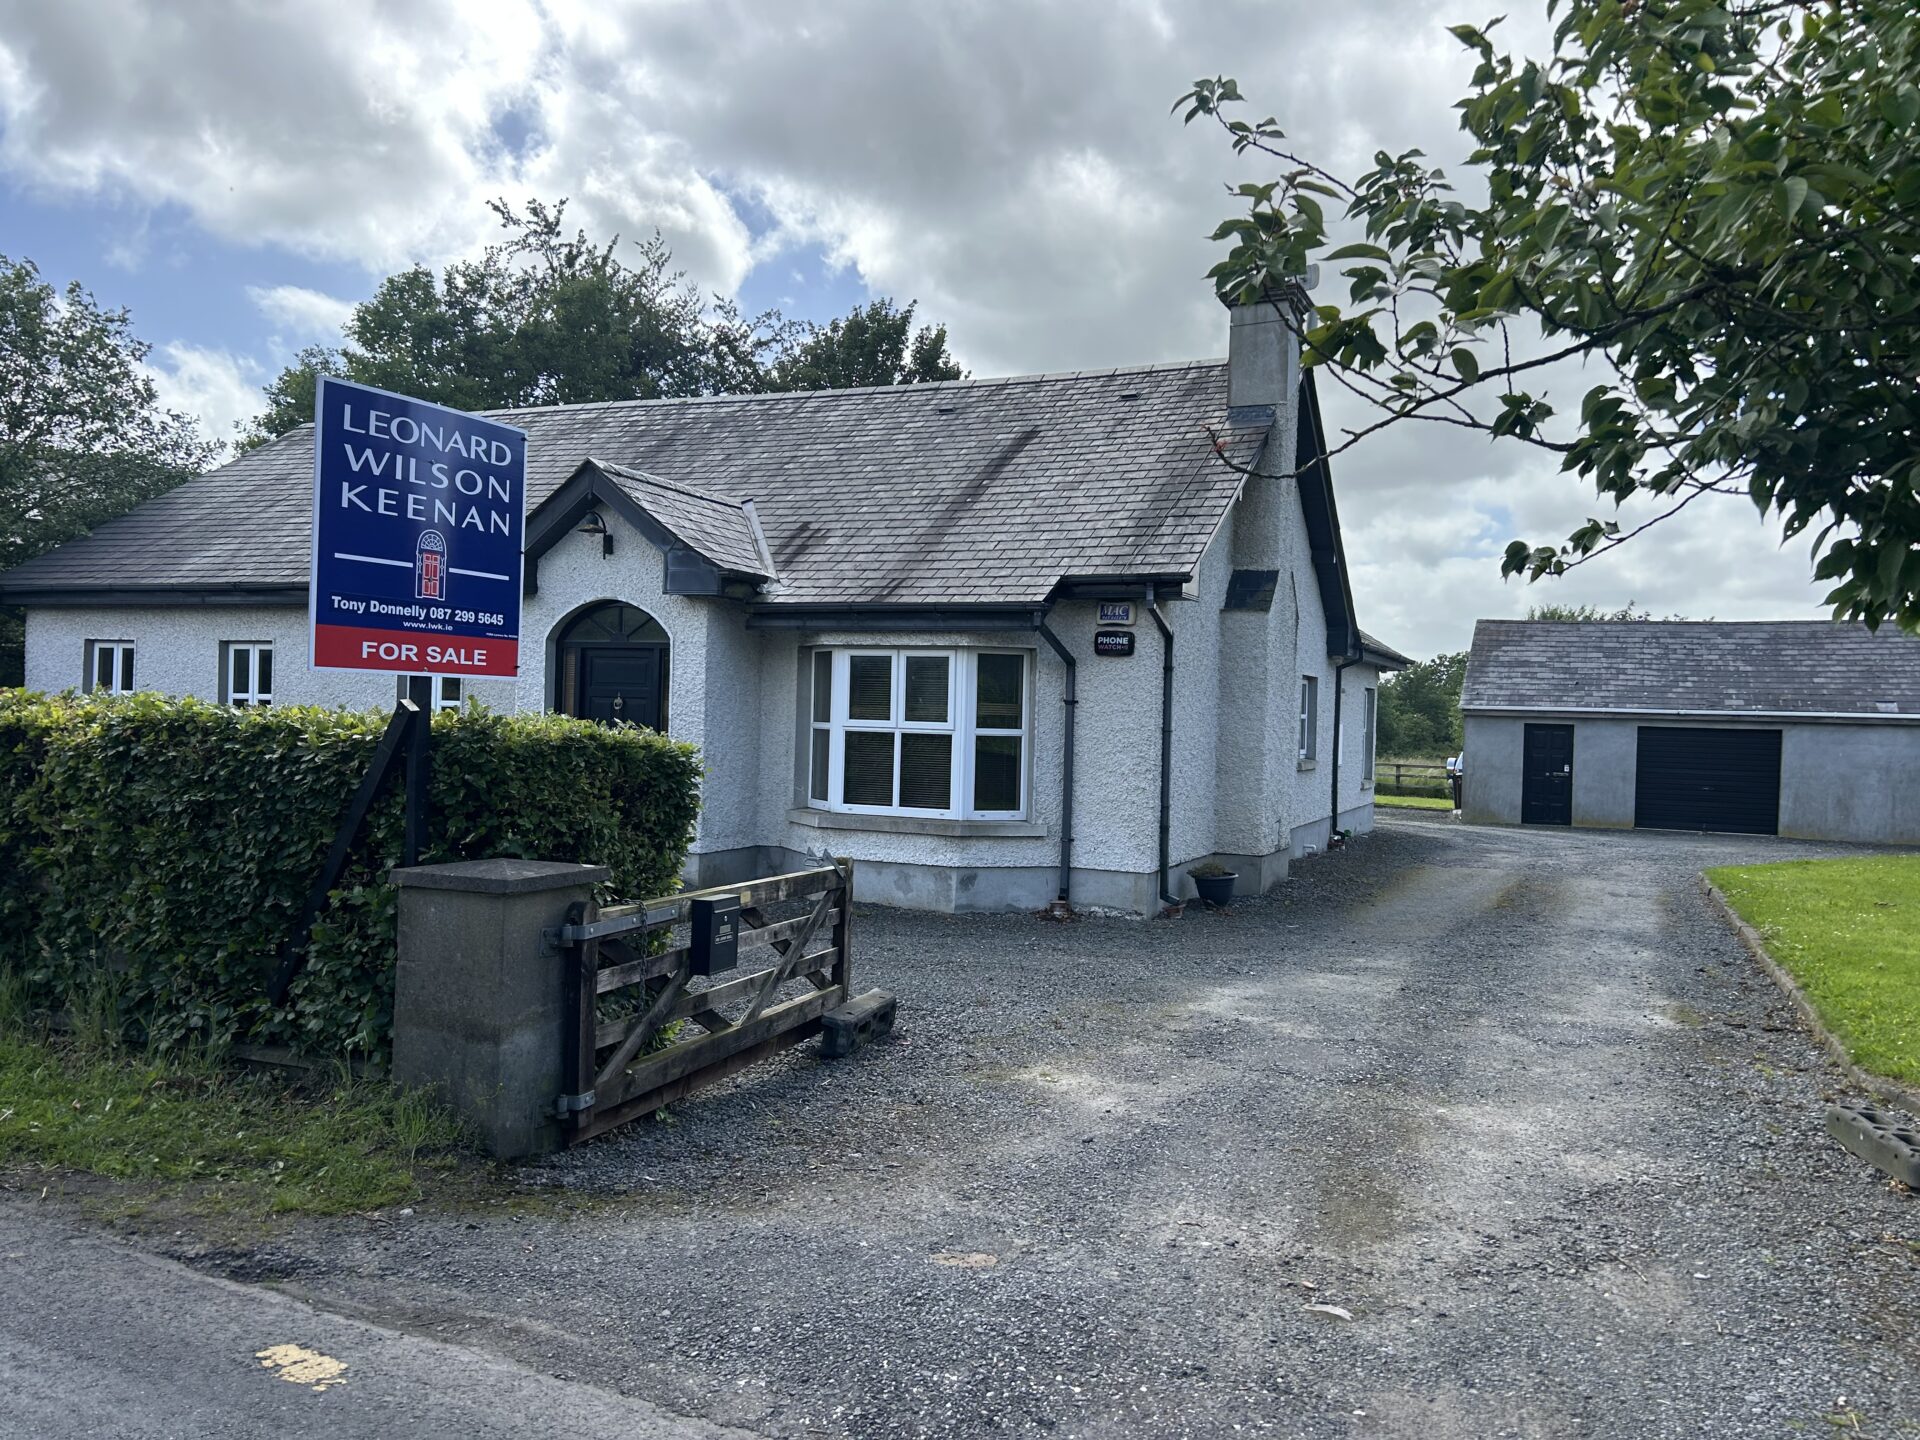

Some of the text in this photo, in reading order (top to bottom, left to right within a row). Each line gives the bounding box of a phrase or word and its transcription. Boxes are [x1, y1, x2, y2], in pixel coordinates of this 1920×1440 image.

[344, 404, 511, 466] LEONARD
[344, 443, 509, 503] WILSON
[342, 481, 509, 537] KEENAN
[332, 595, 503, 625] Tony Donnelly 087 299 5645
[403, 621, 453, 632] www.lwk.ie
[1098, 636, 1128, 645] PHONE
[362, 641, 487, 666] FOR SALE
